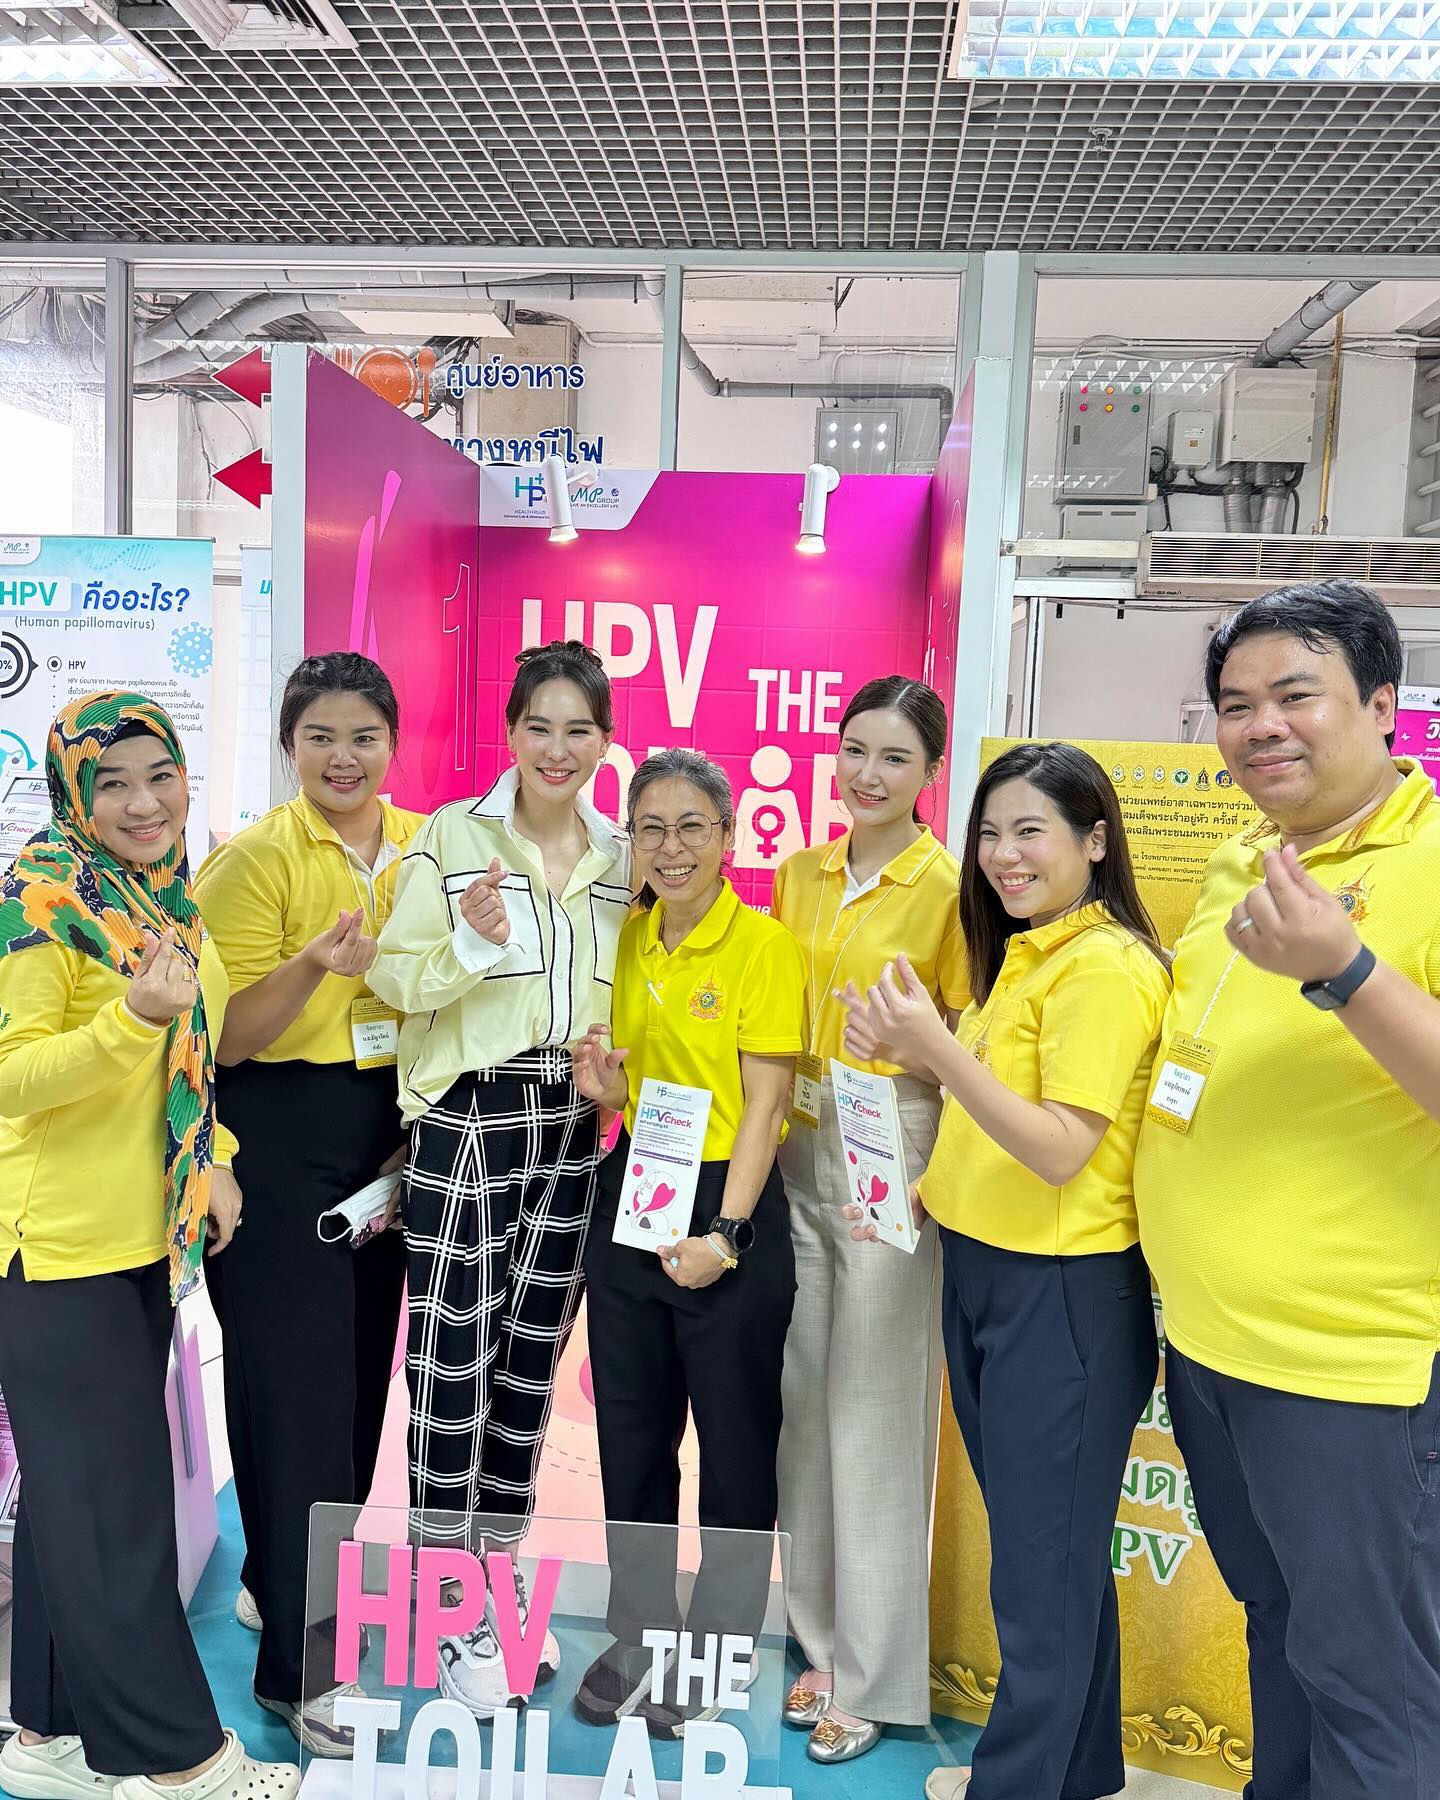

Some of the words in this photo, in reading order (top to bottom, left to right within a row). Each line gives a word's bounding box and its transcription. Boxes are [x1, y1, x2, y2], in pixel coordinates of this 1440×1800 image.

[446, 355, 584, 396] ศูนย์อาหาร
[0, 581, 58, 606] HPV
[83, 580, 190, 612] คืออะไร?
[14, 616, 60, 628] (Human
[64, 617, 156, 631] papillomavirus)
[68, 660, 86, 670] HPV
[749, 668, 843, 734] THE
[1212, 811, 1238, 825] ครั้งที่
[334, 1540, 564, 1695] HPV
[642, 1629, 754, 1710] THE
